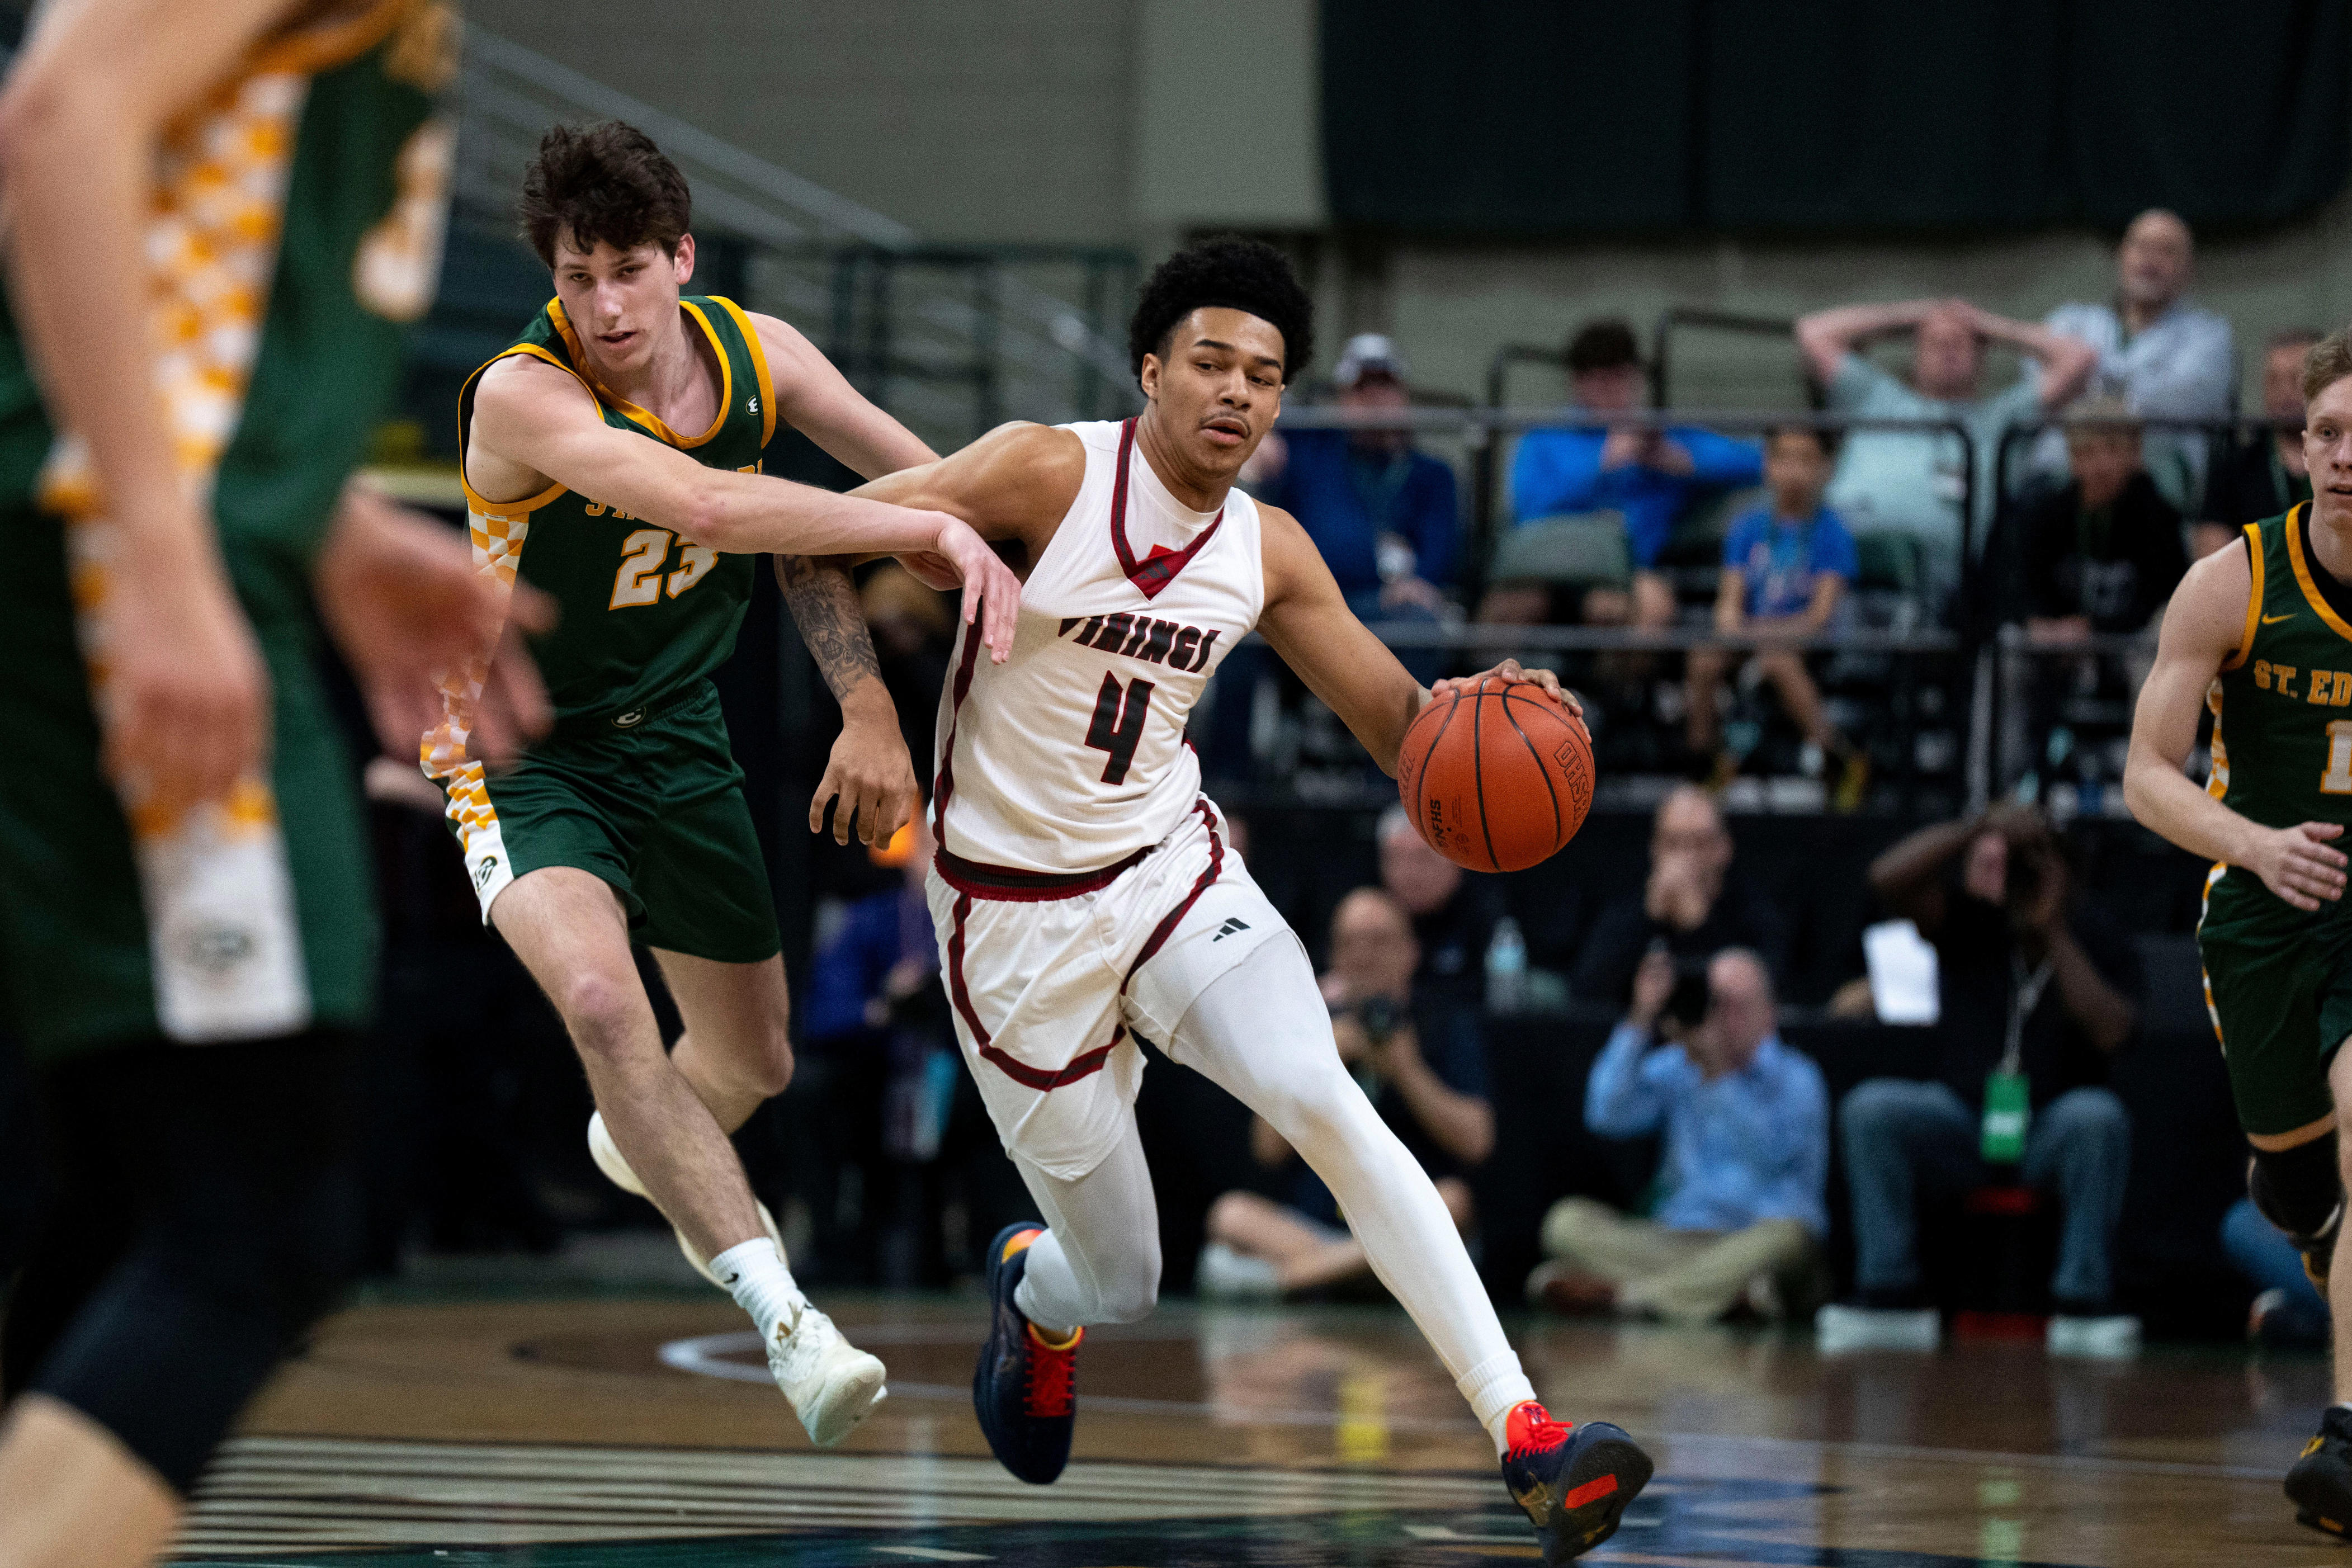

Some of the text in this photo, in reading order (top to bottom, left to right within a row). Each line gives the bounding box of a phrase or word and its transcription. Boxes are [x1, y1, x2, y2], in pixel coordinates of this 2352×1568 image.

[608, 529, 719, 611] 23
[2254, 659, 2352, 707] ST. ED
[1085, 670, 1155, 786] 4
[2320, 719, 2352, 795] 1
